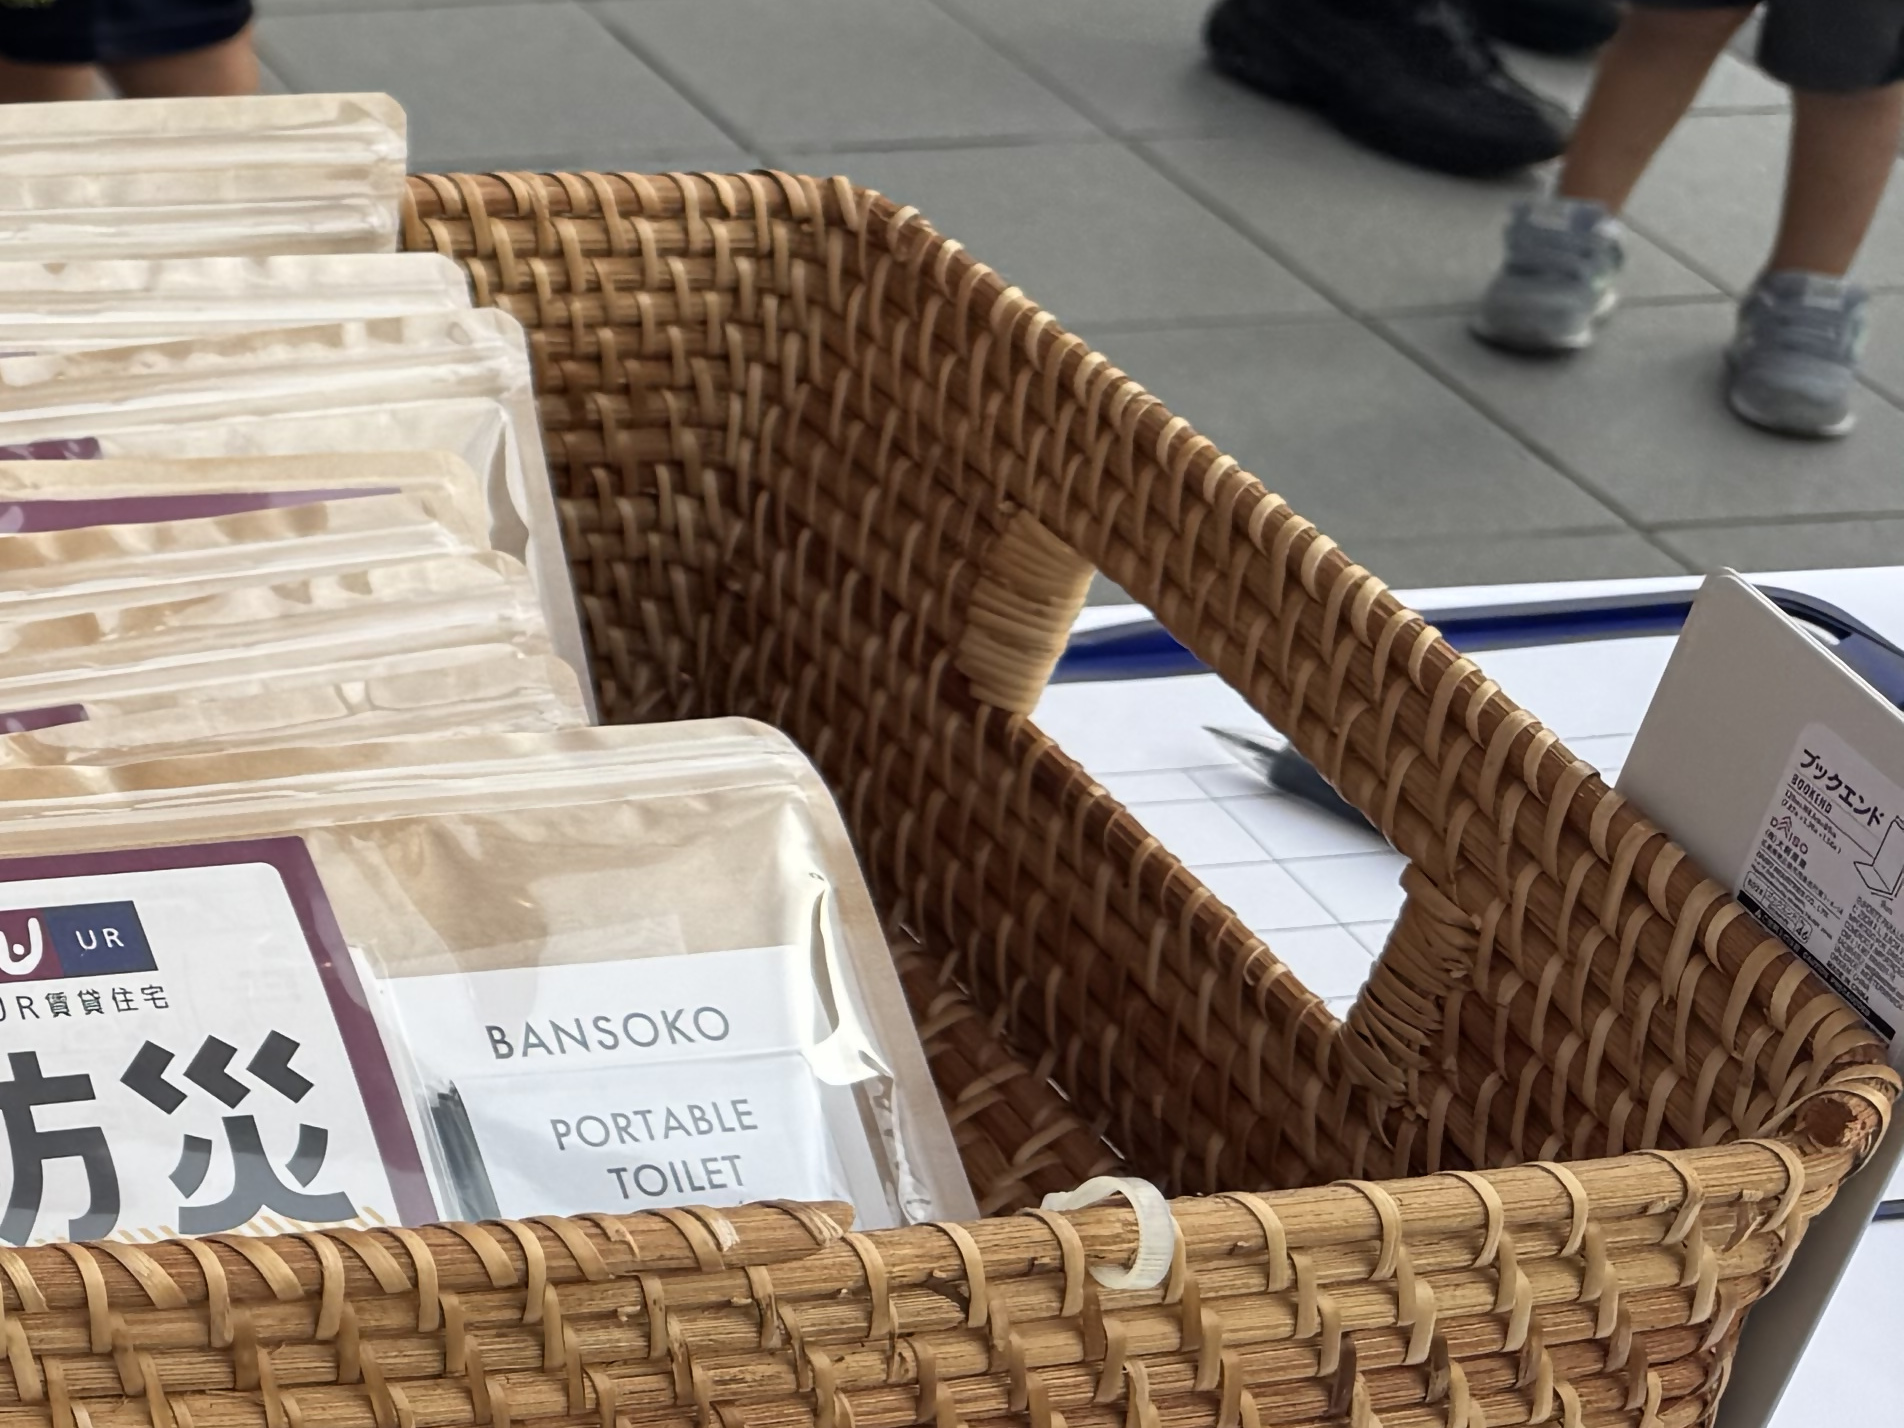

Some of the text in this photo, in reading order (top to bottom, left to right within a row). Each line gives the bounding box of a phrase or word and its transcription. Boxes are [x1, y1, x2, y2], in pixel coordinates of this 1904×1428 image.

[1791, 773, 1833, 814] BOOKEND
[1799, 748, 1886, 827] ブックエンド
[74, 927, 125, 951] UR
[485, 1005, 730, 1060] BANSOKO
[550, 1098, 759, 1151] PORTABLE
[606, 1154, 745, 1200] TOILET
